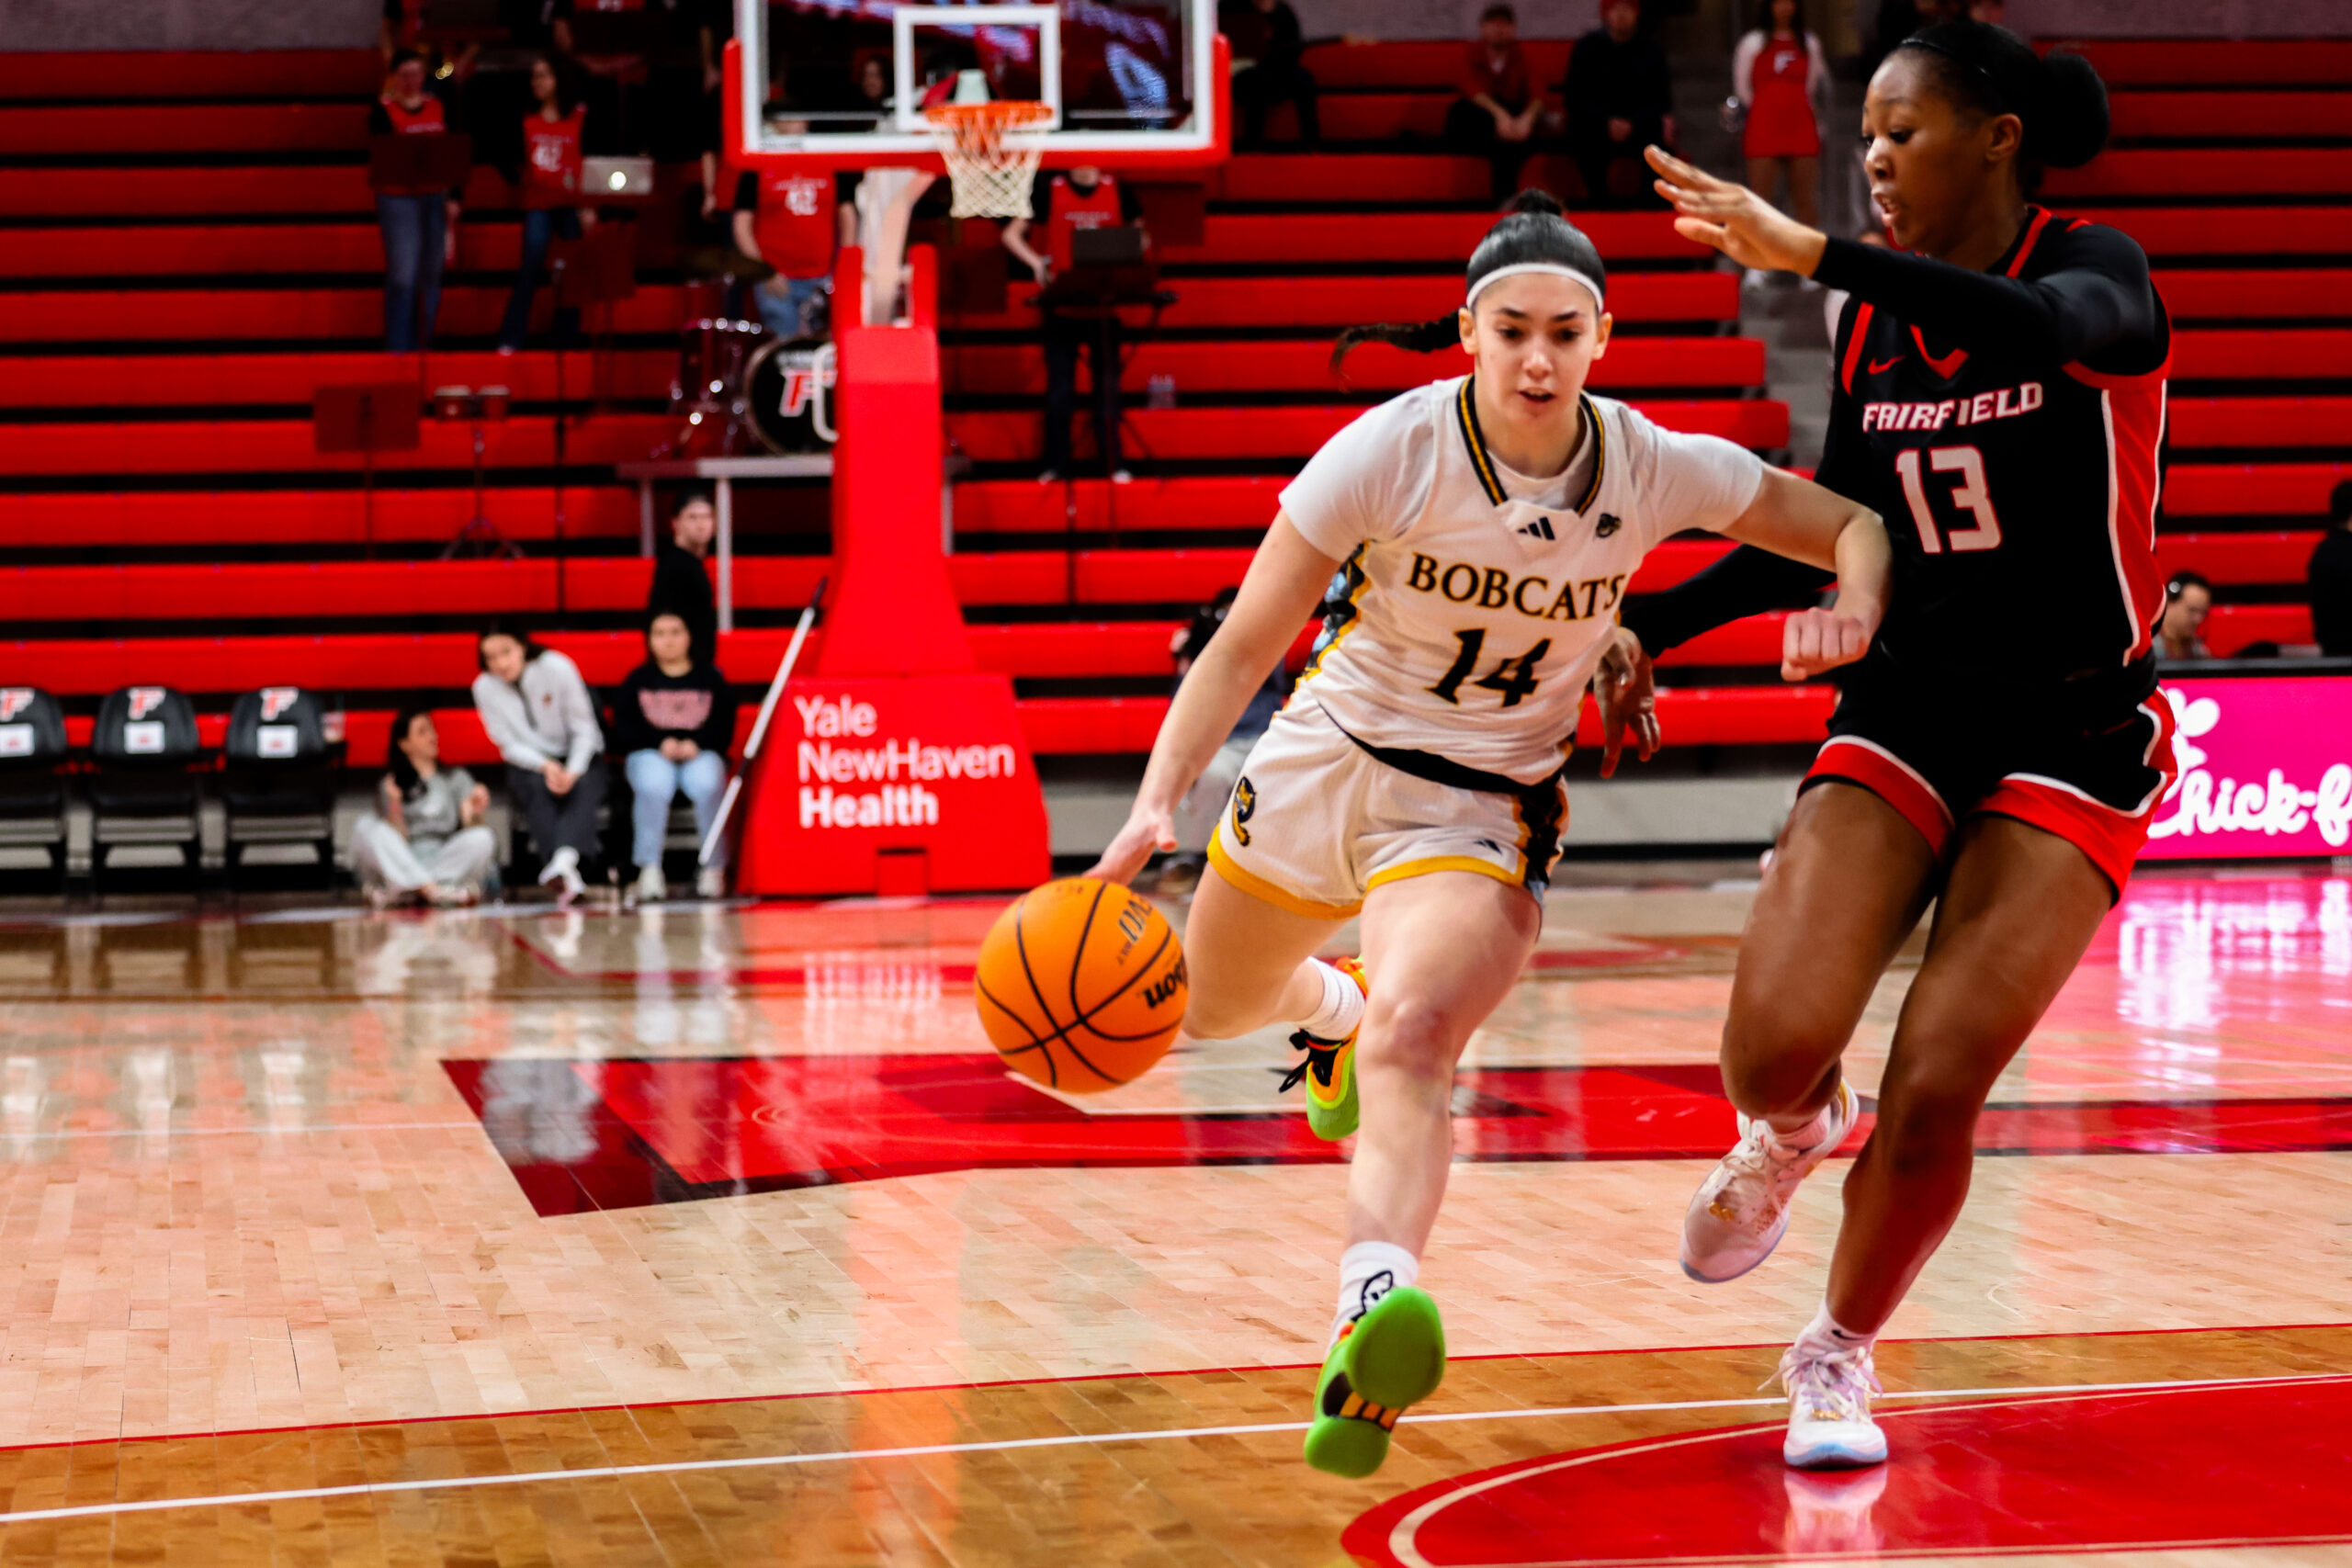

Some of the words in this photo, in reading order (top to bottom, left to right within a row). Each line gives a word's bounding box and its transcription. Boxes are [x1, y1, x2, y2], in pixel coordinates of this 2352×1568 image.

[1862, 381, 2044, 433] FAIRFIELD
[1894, 445, 2003, 554] 13
[1405, 552, 1626, 621] BOBCATS
[1424, 627, 1553, 708] 14
[794, 694, 877, 738] Yale
[797, 738, 1015, 783] NewHaven
[799, 784, 939, 829] Health
[2147, 738, 2352, 847] hick-f
